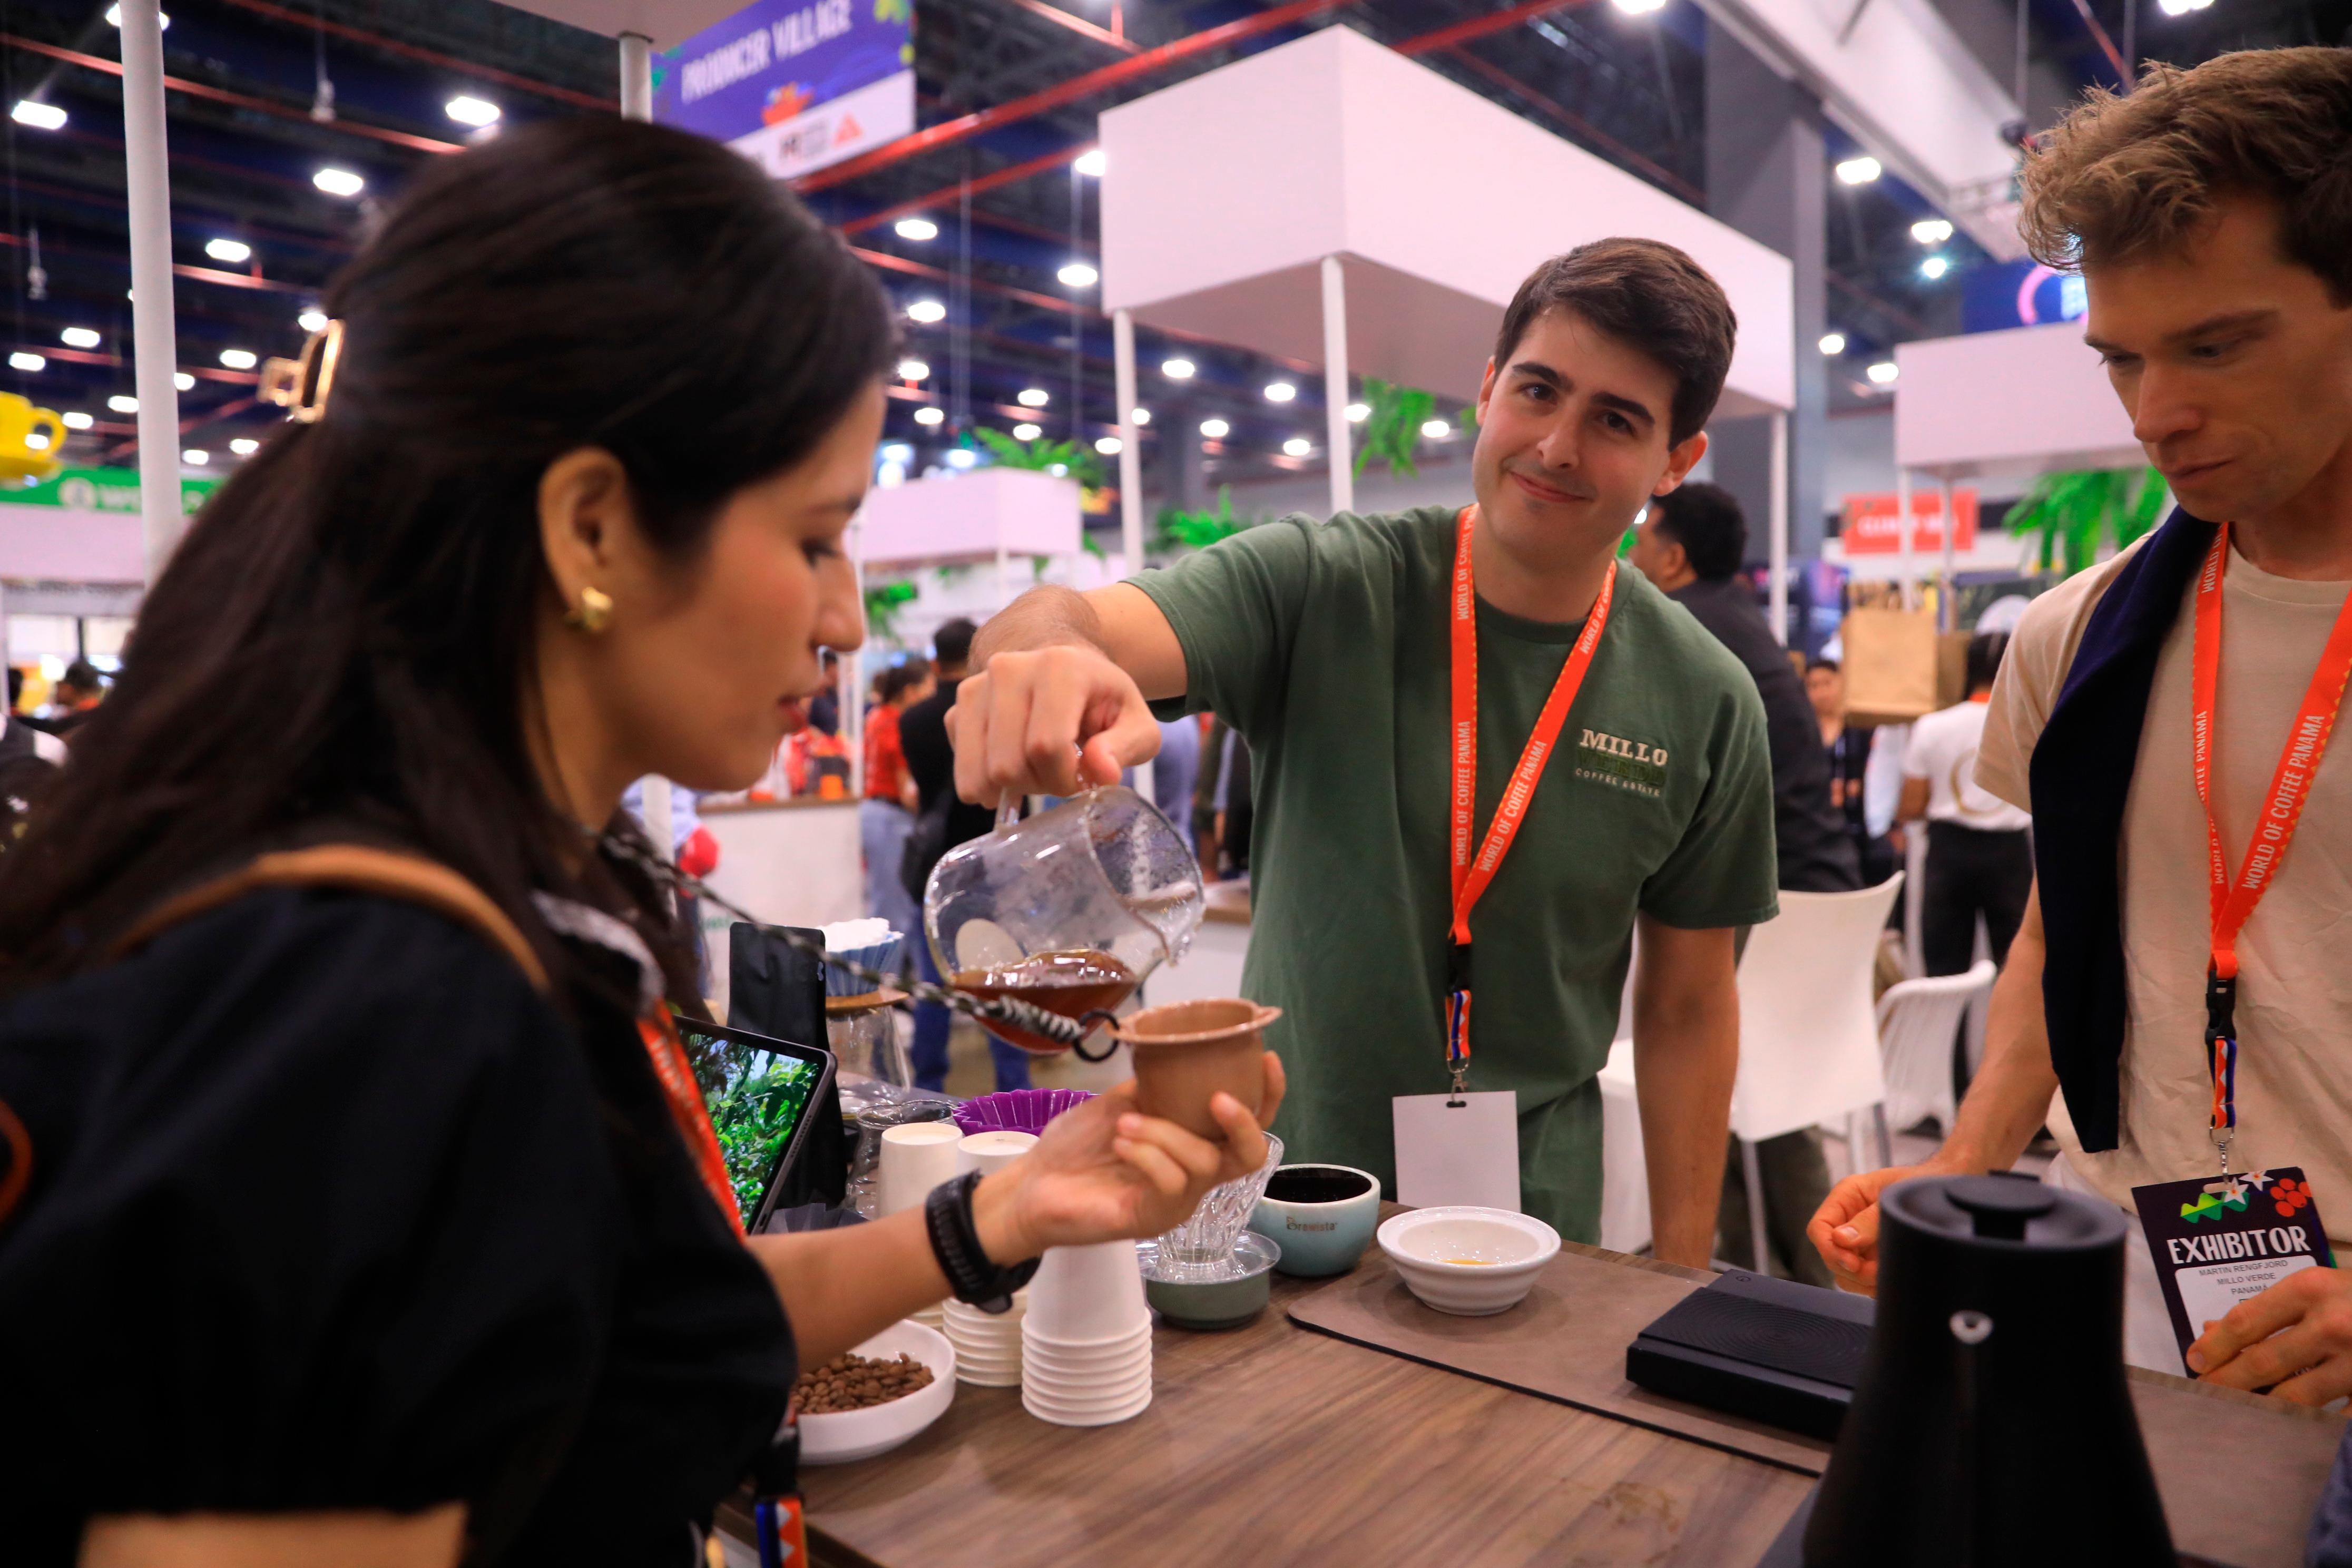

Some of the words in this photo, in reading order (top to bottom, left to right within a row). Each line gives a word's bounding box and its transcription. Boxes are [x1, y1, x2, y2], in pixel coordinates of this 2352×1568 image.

[771, 0, 852, 62] VILLAGE
[1457, 569, 1467, 581] OF
[2201, 551, 2219, 593] WORLD
[1457, 584, 1469, 620] WORLD
[1579, 619, 1600, 654] WORLD
[1458, 721, 1471, 763] PANAMA
[1580, 729, 1669, 767] MILLO
[2196, 710, 2208, 762] PANAMA
[2288, 715, 2326, 769] PANAMA
[1520, 740, 1547, 781] PANAMA
[1458, 767, 1471, 806] COFFEE
[1504, 780, 1530, 817] COFFEE
[1575, 768, 1618, 786] COFFEE
[1623, 780, 1660, 798] ESTATE
[2270, 770, 2304, 819] COFFEE
[1457, 810, 1468, 824] OF
[1497, 818, 1512, 835] OF
[2262, 821, 2285, 841] OF
[1456, 828, 1467, 866] WORLD
[1479, 835, 1505, 872] WORLD
[2241, 844, 2276, 889] WORLD
[2167, 1226, 2311, 1265] EXHIBITOR
[2199, 1266, 2232, 1276] MARTIN
[2217, 1276, 2244, 1286] MILLO
[2246, 1272, 2276, 1282] VERDE
